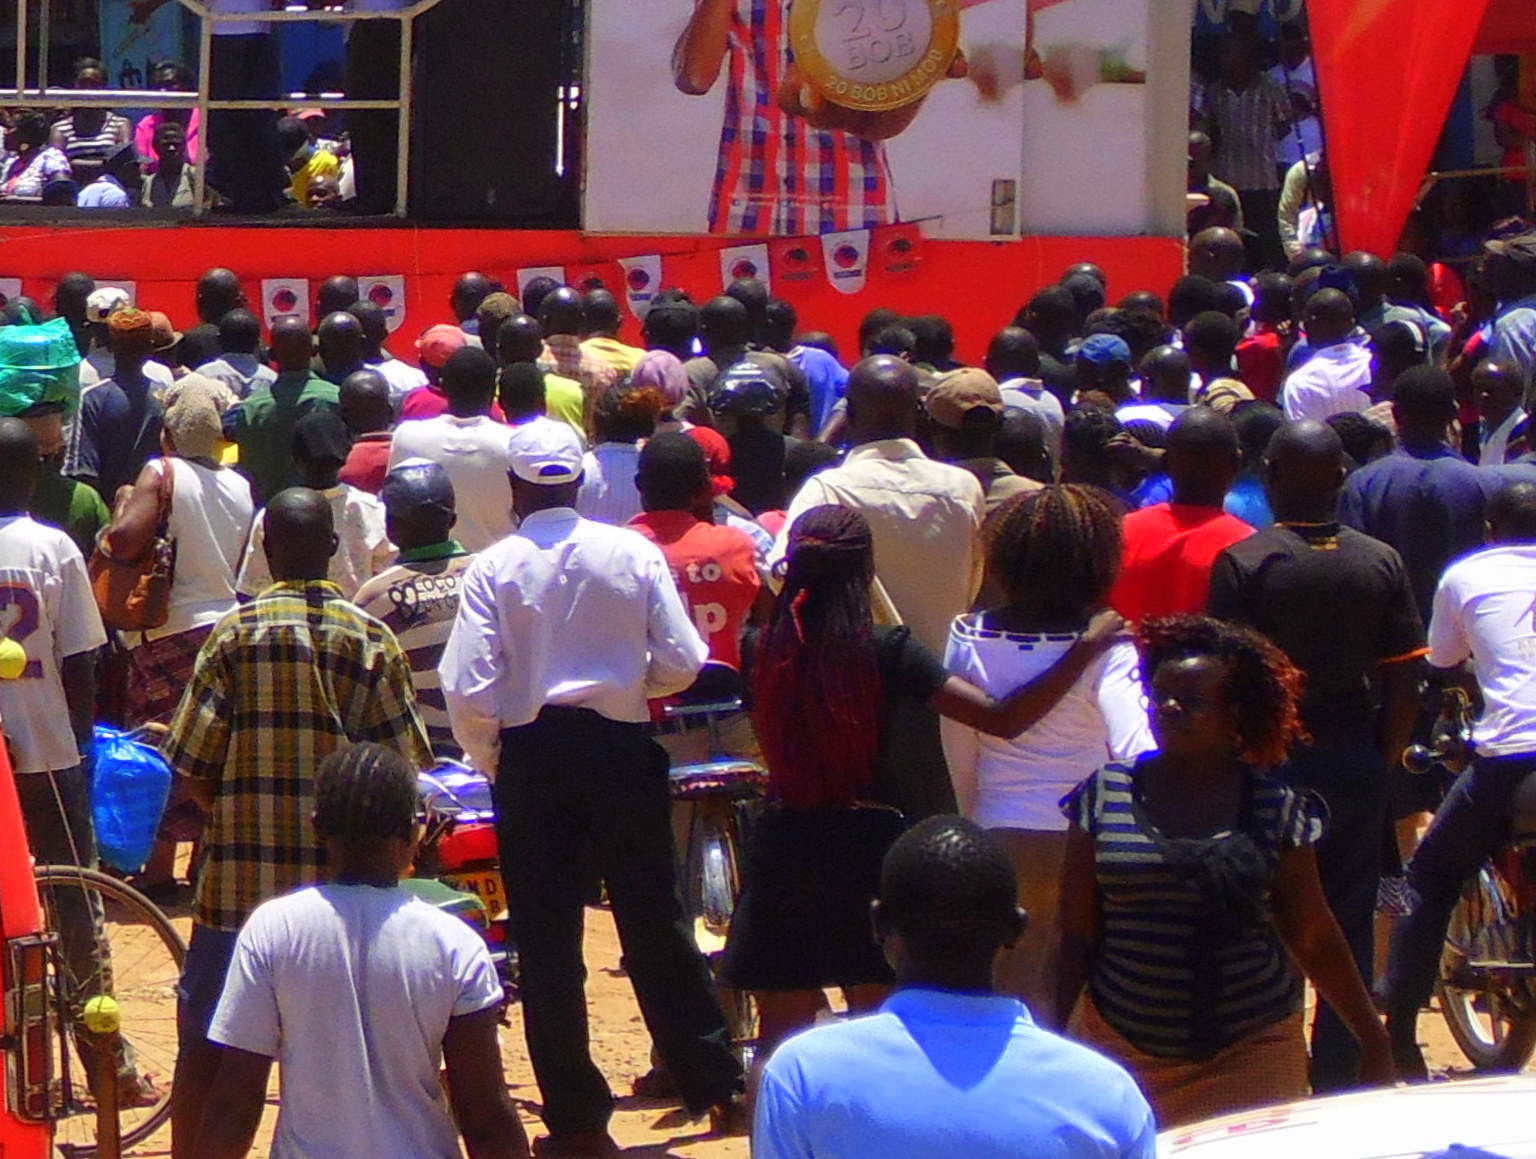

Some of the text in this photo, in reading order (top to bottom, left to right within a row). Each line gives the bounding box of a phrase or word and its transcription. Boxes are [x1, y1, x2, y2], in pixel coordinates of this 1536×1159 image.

[826, 48, 943, 102] 20 BOB NI MOB
